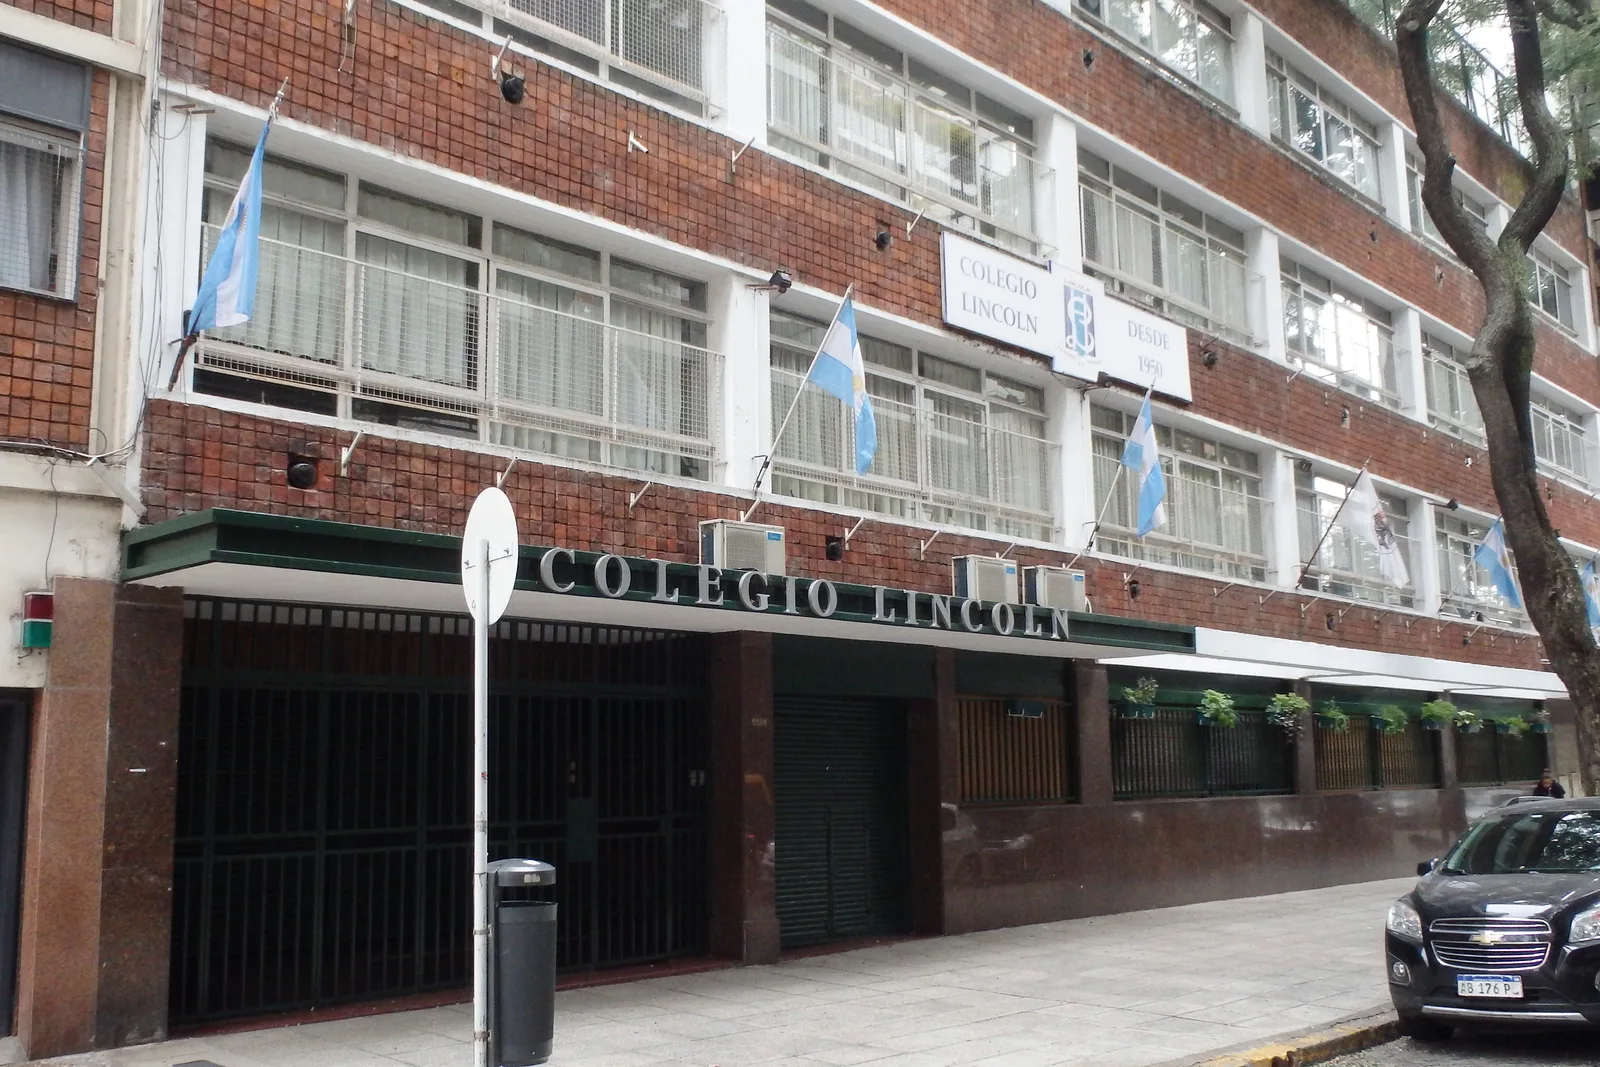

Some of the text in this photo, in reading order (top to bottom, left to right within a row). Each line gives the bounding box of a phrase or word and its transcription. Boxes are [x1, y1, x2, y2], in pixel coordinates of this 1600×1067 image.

[960, 256, 1037, 300] COLEGIO
[961, 291, 1039, 335] LINCOLN
[1127, 320, 1170, 350] DESDE
[1138, 355, 1163, 378] 1950
[540, 547, 1069, 640] COLEGIO LINCOLN
[1477, 983, 1499, 995] 176
[1503, 983, 1519, 996] P
